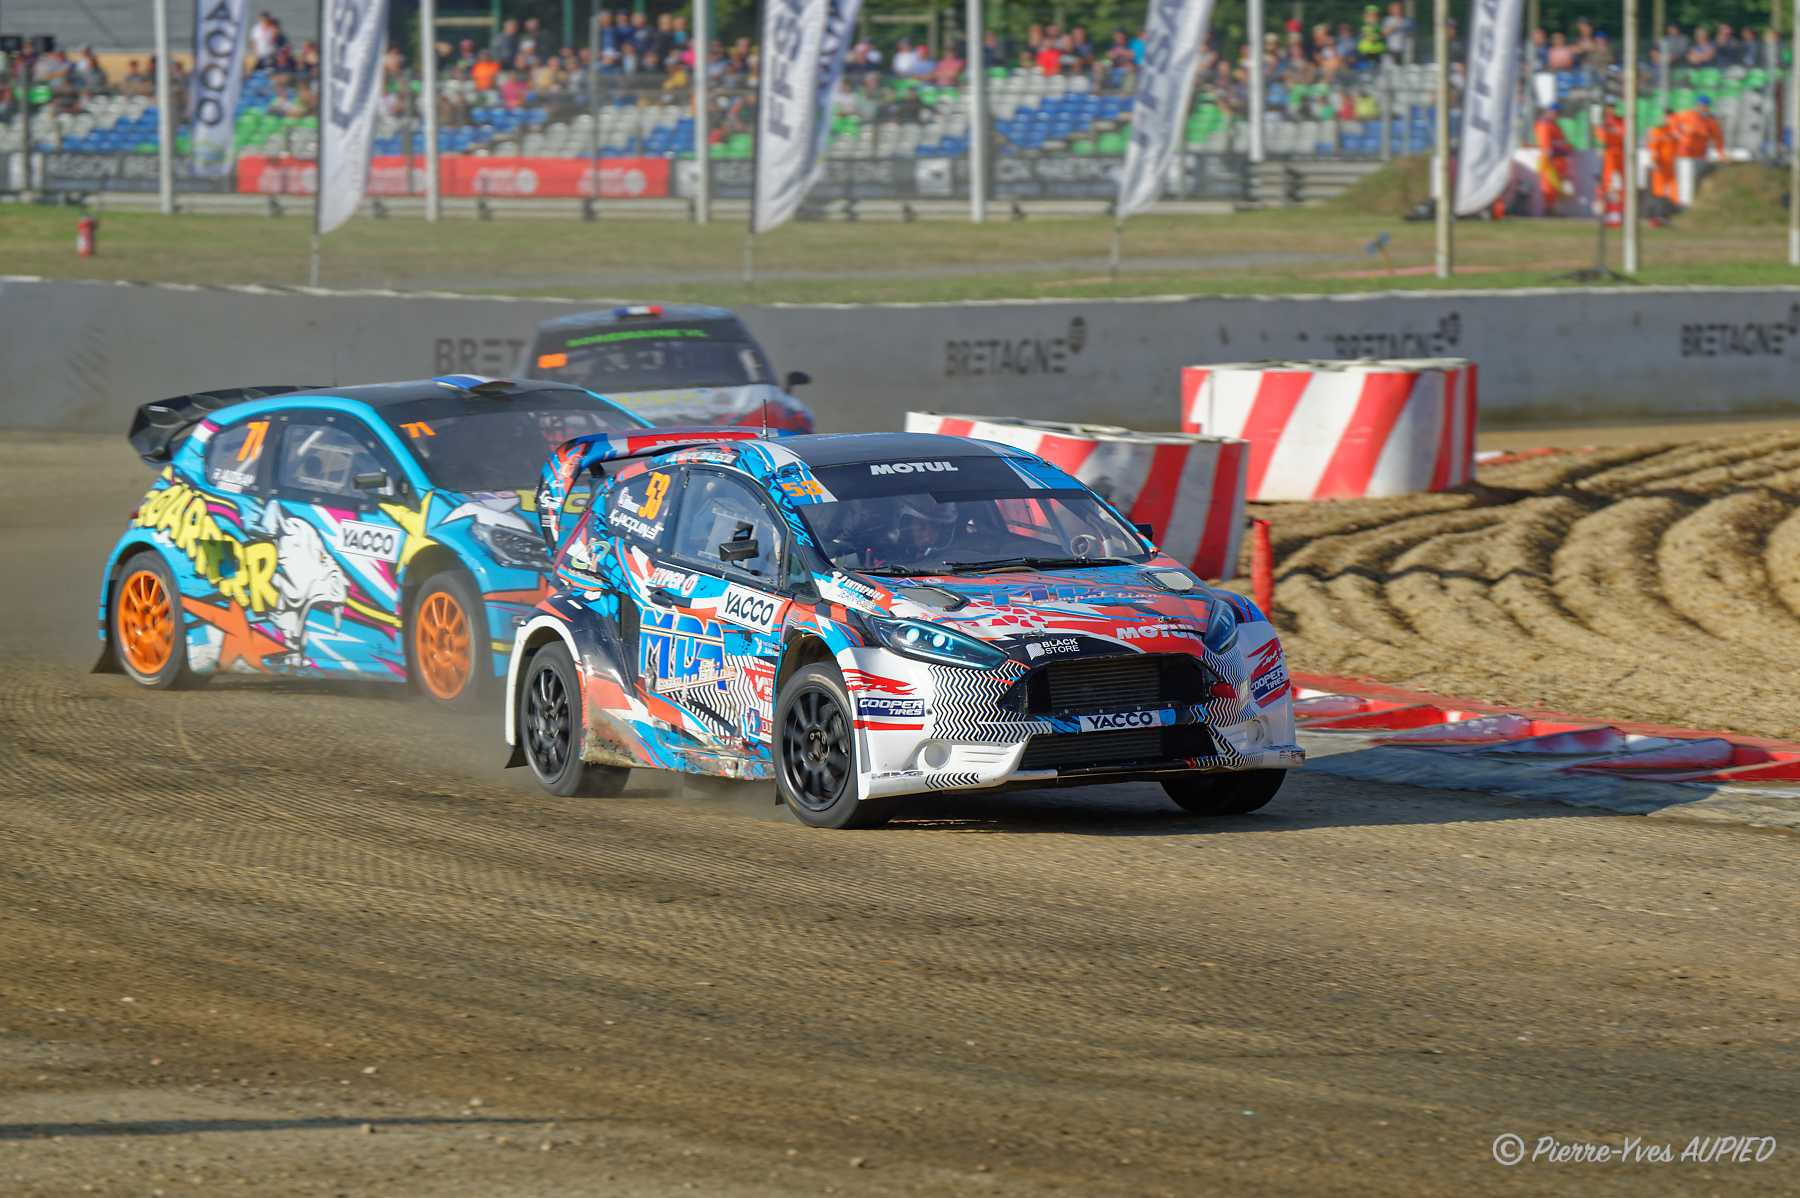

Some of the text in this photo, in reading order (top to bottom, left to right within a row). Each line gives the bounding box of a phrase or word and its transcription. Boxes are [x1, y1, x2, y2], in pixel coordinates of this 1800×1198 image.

[1682, 323, 1784, 357] BRETAGNE
[946, 338, 1067, 376] BRETAGNE
[869, 461, 959, 476] MOTUL
[780, 479, 824, 497] 53
[342, 528, 393, 554] YACCO
[725, 591, 774, 626] YACCO
[1116, 624, 1203, 642] MOTUL
[1042, 638, 1079, 648] BLACK
[1044, 645, 1081, 655] STORE
[859, 698, 924, 709] COOPER
[888, 708, 923, 716] TIRES
[1088, 712, 1153, 729] YACCO
